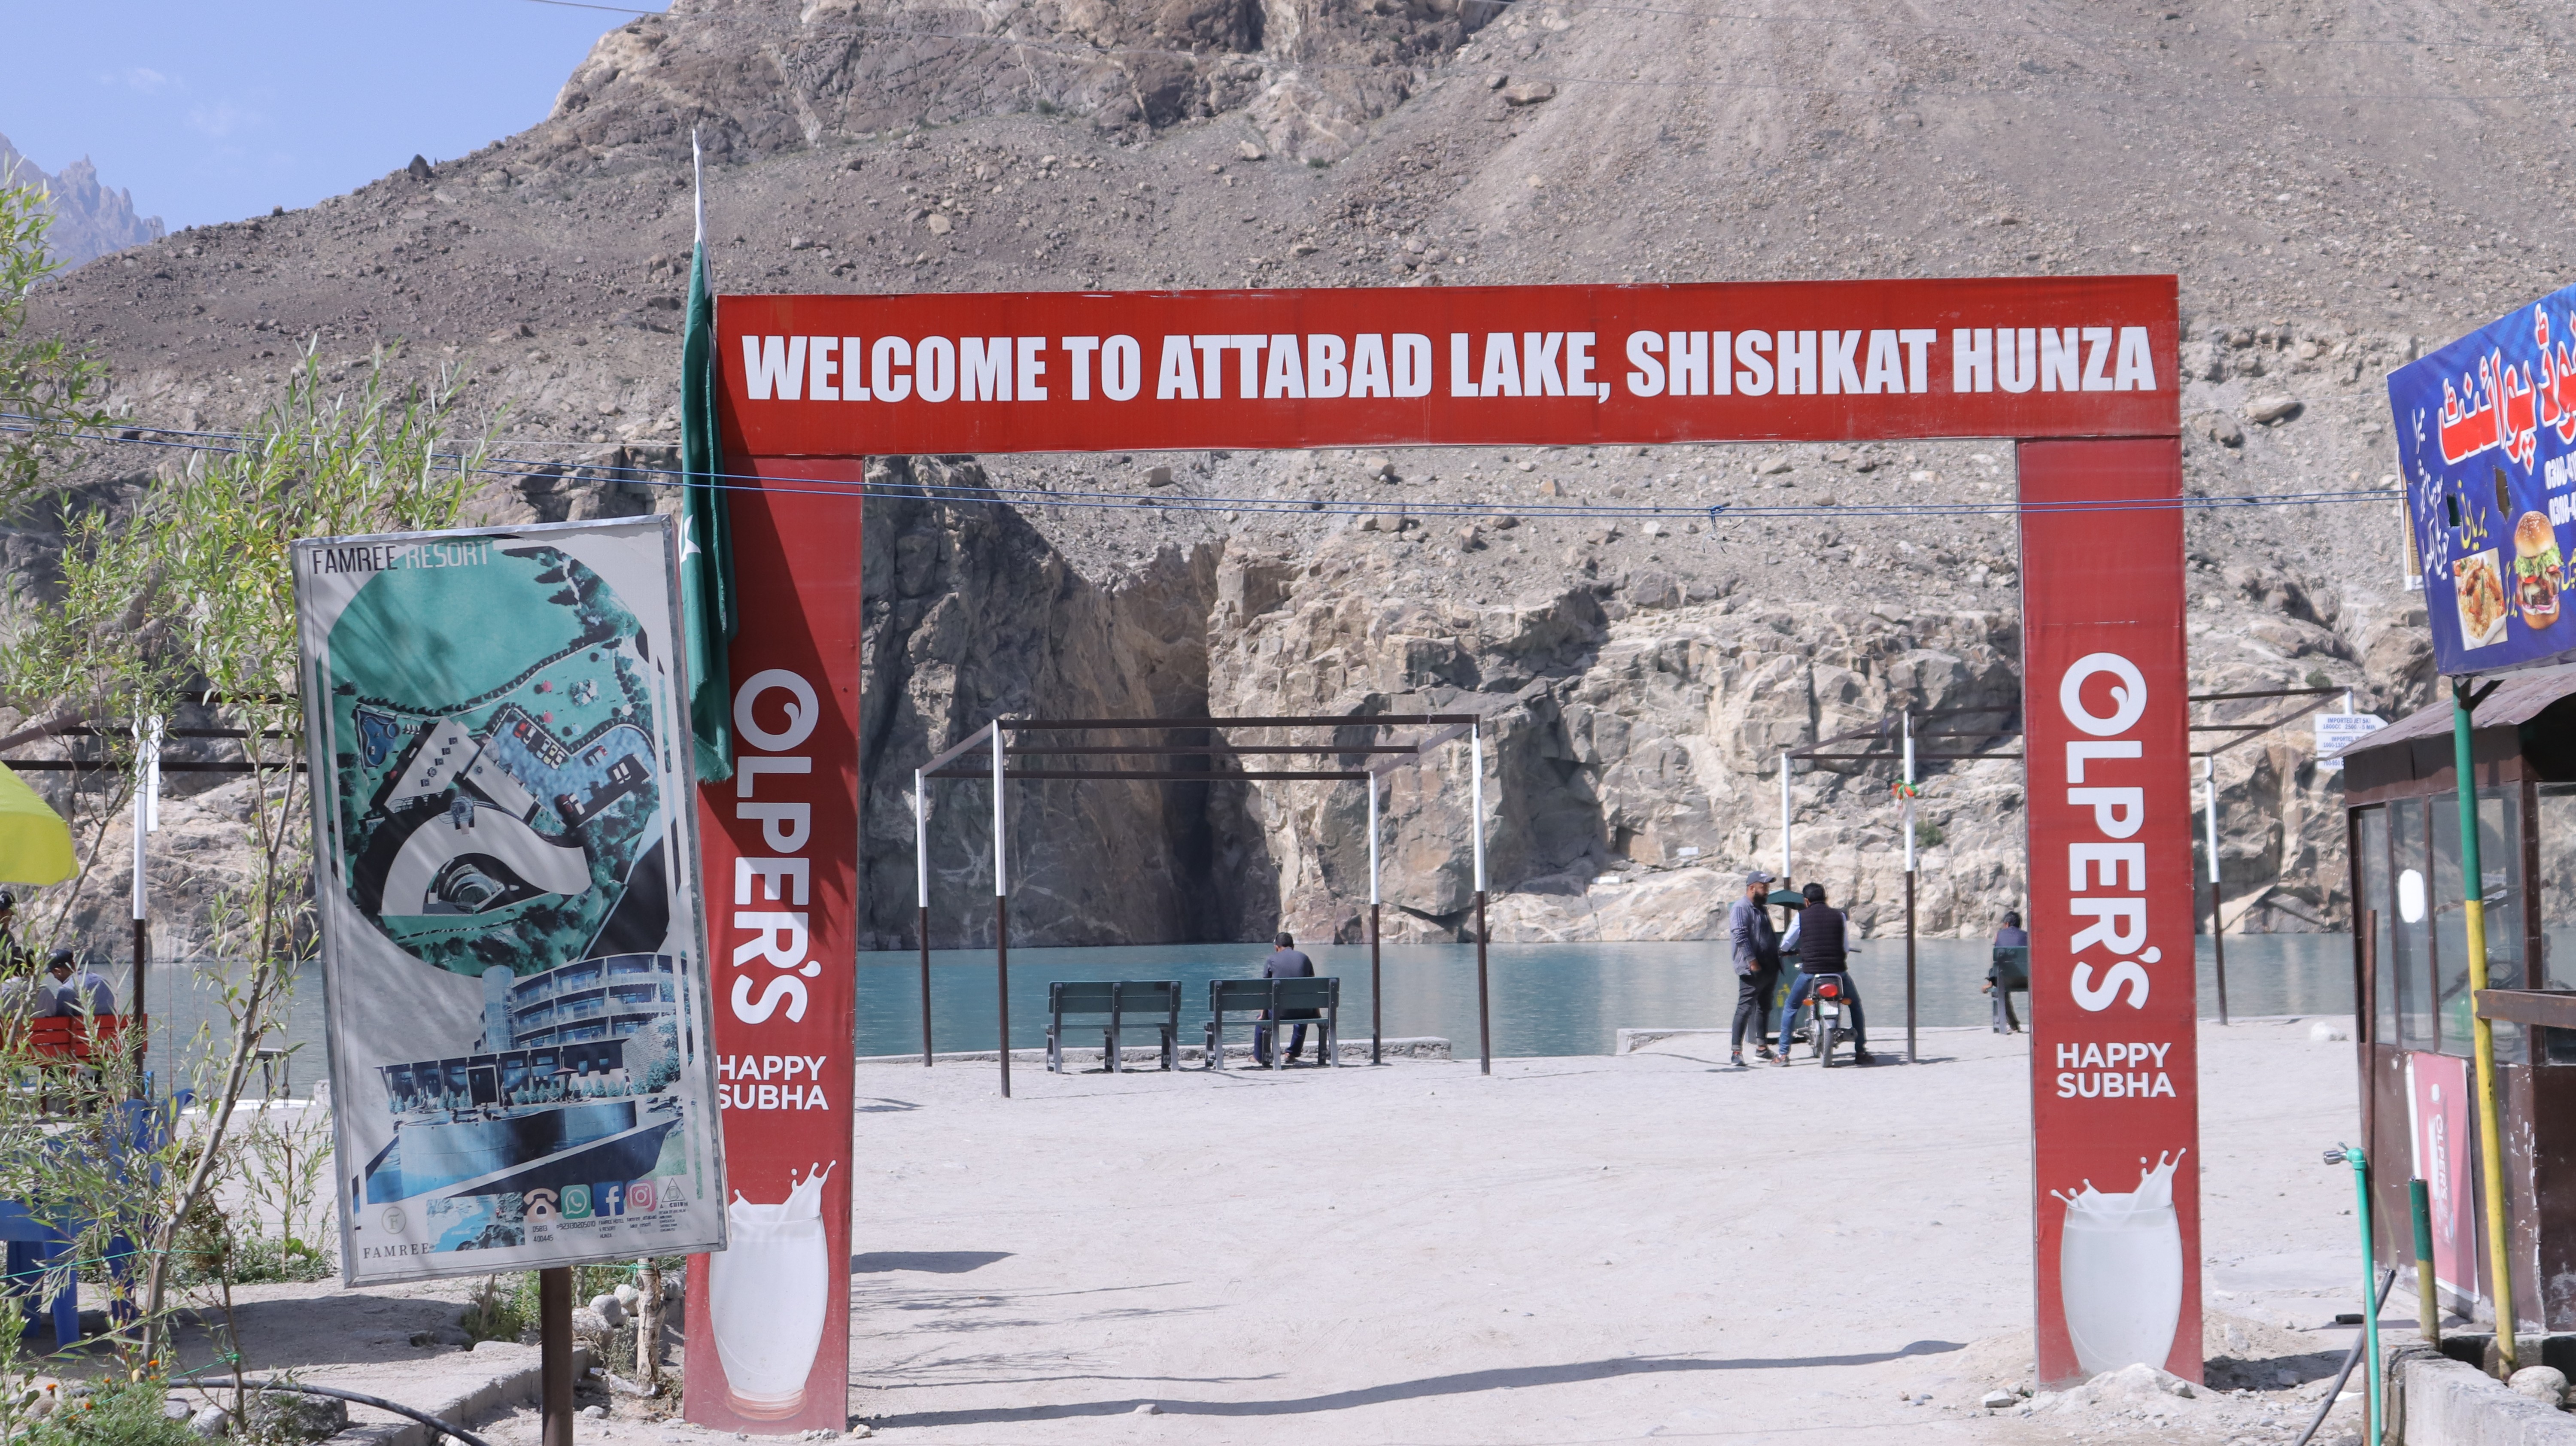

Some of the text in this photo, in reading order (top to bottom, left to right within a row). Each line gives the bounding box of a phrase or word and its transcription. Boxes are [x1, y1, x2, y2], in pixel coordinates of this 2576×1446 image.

[742, 326, 2157, 404] WELCOME TO ATTABAD LAKE, SHISHKAT HUNZA
[312, 540, 489, 574] FAMREE RESORT
[2060, 652, 2161, 1012] OLPER'S
[731, 668, 821, 1024] OLPER'S
[717, 1055, 826, 1081] HAPPY
[2057, 1042, 2171, 1068] HAPPY
[719, 1084, 829, 1110] SUBHA
[2057, 1072, 2176, 1098] SUBHA
[363, 1242, 429, 1259] FAMREE
